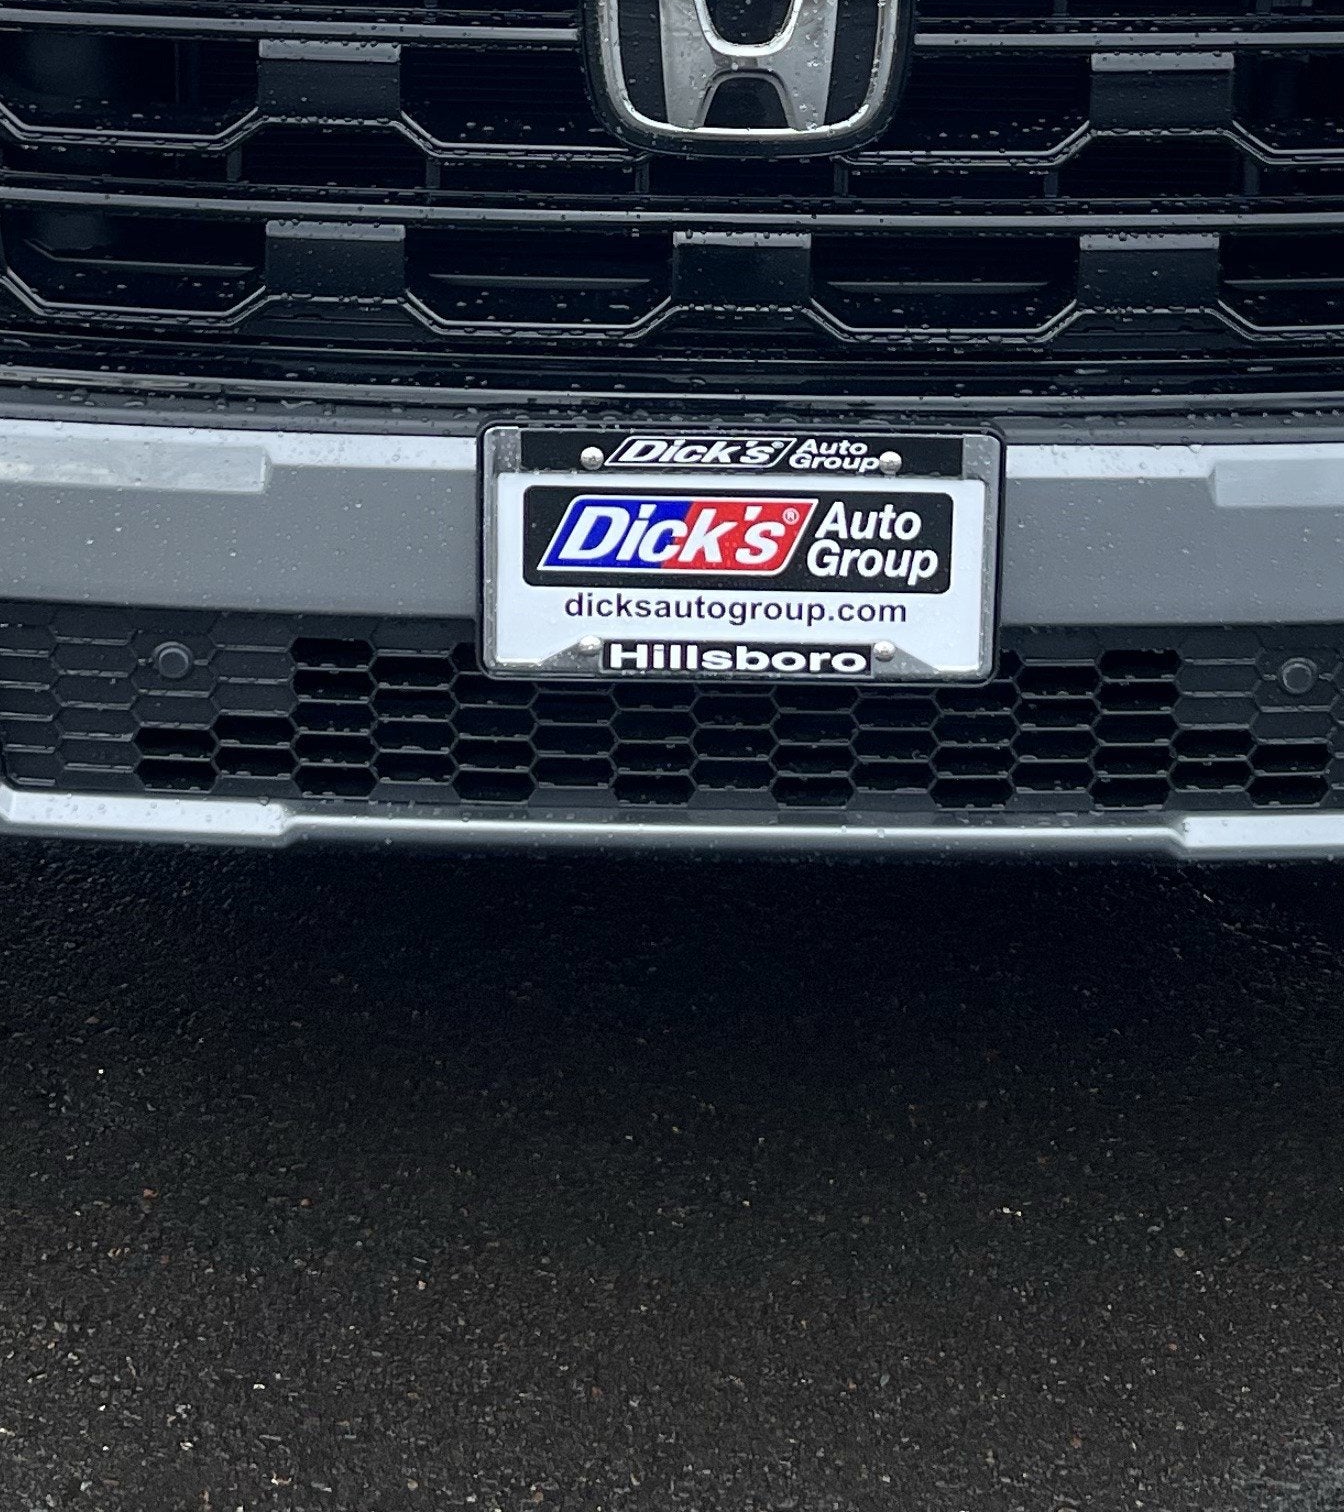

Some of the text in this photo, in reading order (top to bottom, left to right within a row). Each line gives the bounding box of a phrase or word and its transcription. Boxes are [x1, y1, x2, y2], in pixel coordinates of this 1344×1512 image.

[619, 439, 775, 464] Dick's
[797, 438, 868, 456] Auto
[789, 454, 880, 473] Group
[558, 503, 786, 565] Dick's
[815, 501, 922, 541] Auto
[807, 539, 939, 586] Group
[564, 592, 907, 626] dicksautogroup.com
[609, 643, 867, 673] Hillsboro
